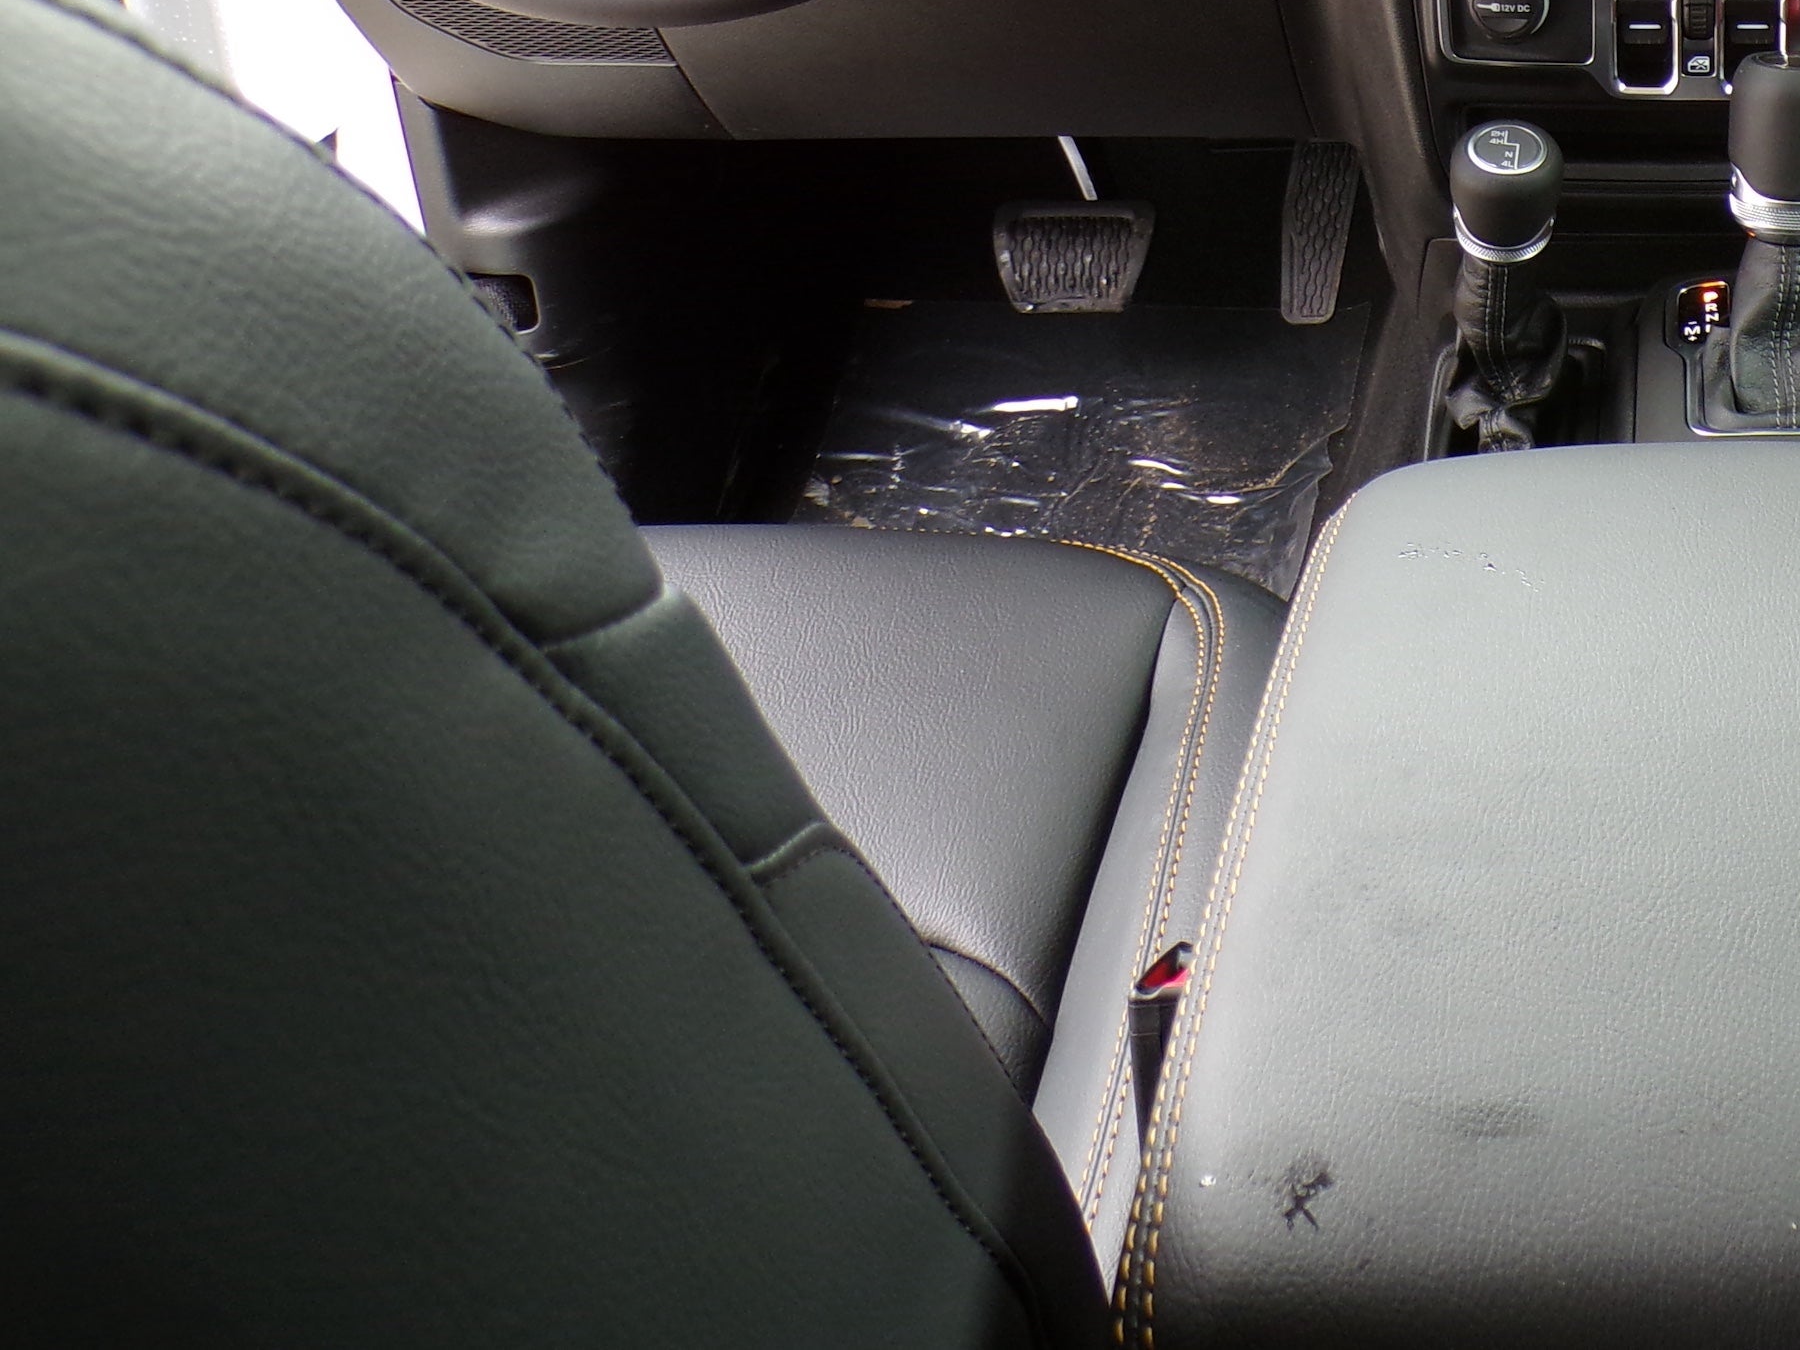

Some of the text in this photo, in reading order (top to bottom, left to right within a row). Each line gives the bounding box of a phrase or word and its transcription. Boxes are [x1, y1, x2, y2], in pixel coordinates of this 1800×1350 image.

[1501, 4, 1531, 13] 12V DC
[1501, 160, 1514, 168] 4L
[1705, 302, 1718, 312] R
[1705, 312, 1719, 322] N
[1684, 325, 1701, 336] M
